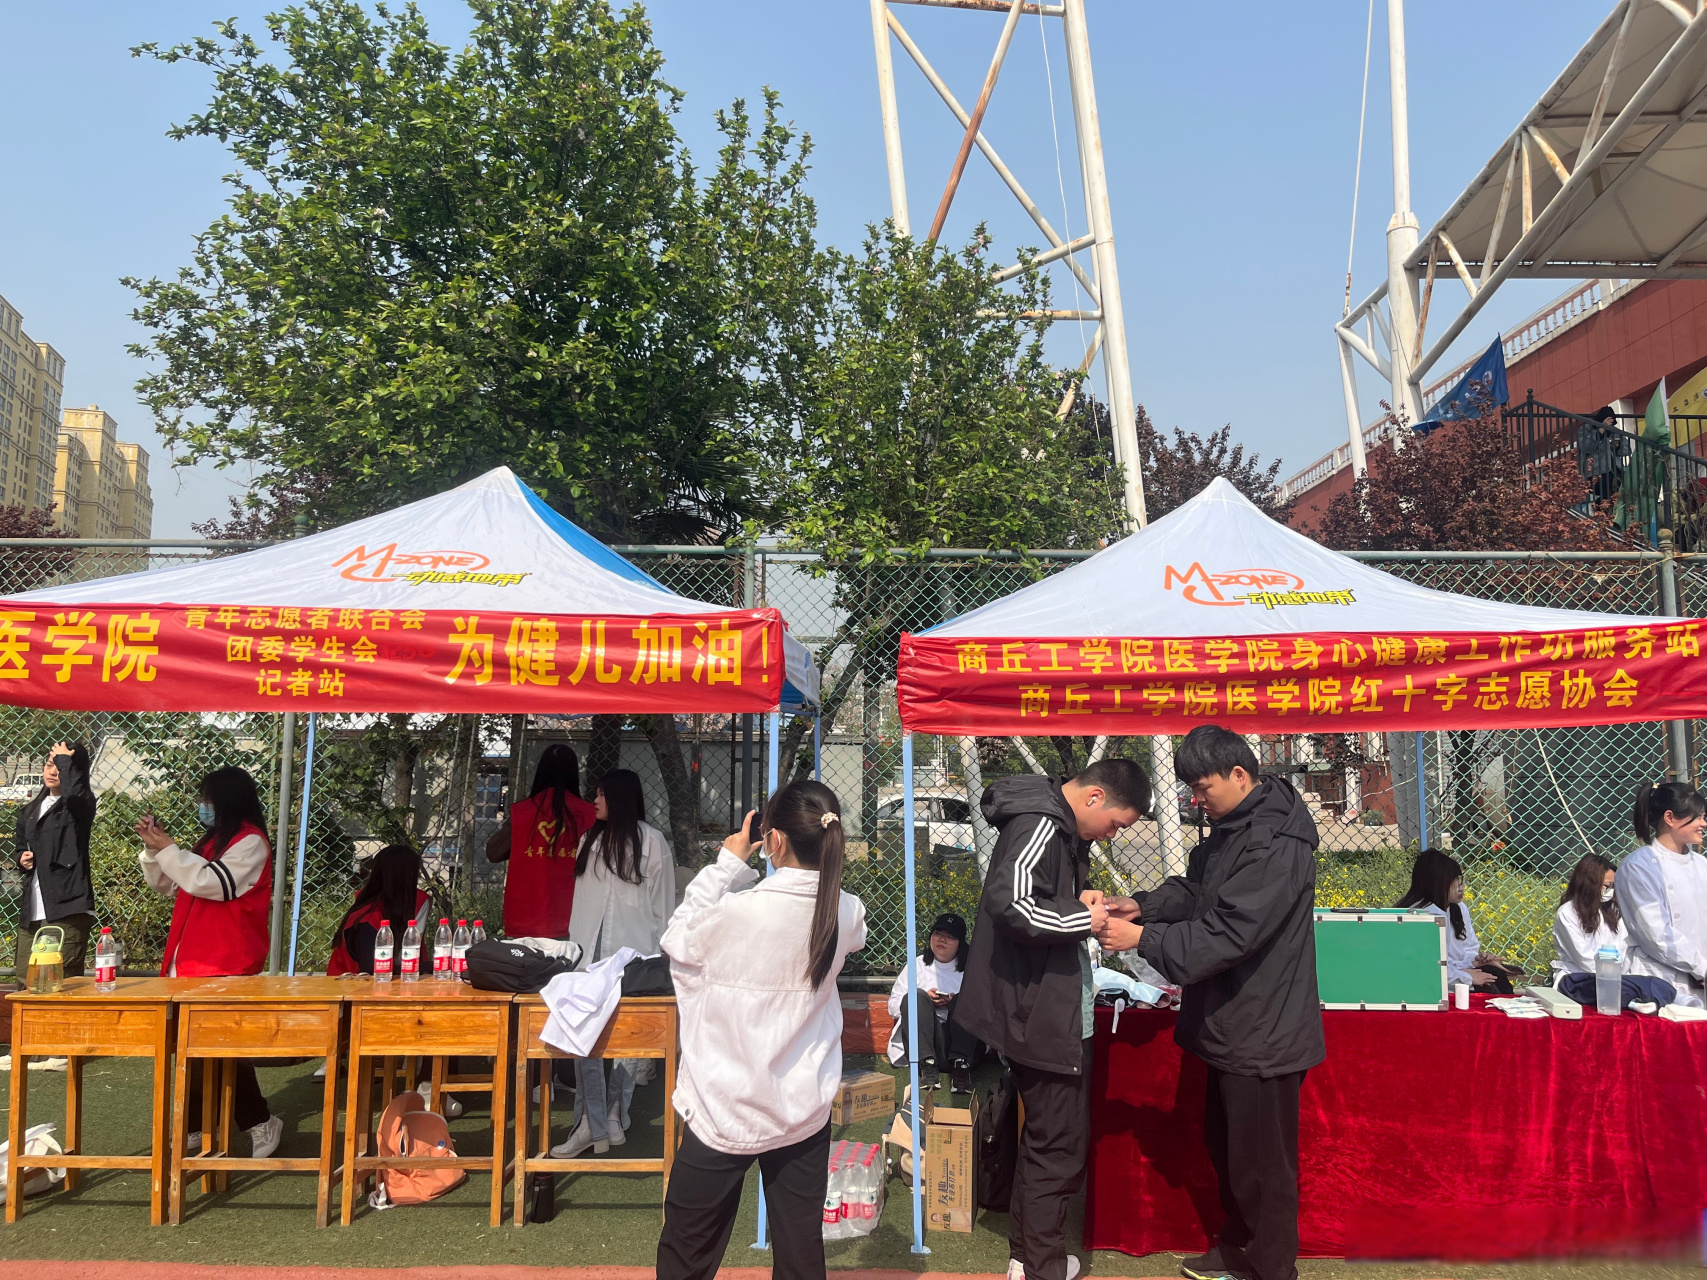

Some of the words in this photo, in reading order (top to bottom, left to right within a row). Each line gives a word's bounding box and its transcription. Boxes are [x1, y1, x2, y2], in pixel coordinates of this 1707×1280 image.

[184, 607, 427, 631] 青年志愿者联合会
[226, 635, 379, 664] 团委学生会
[256, 668, 347, 697] 记者站
[1018, 667, 1640, 719] 商丘工学院医学院红十字志愿协会
